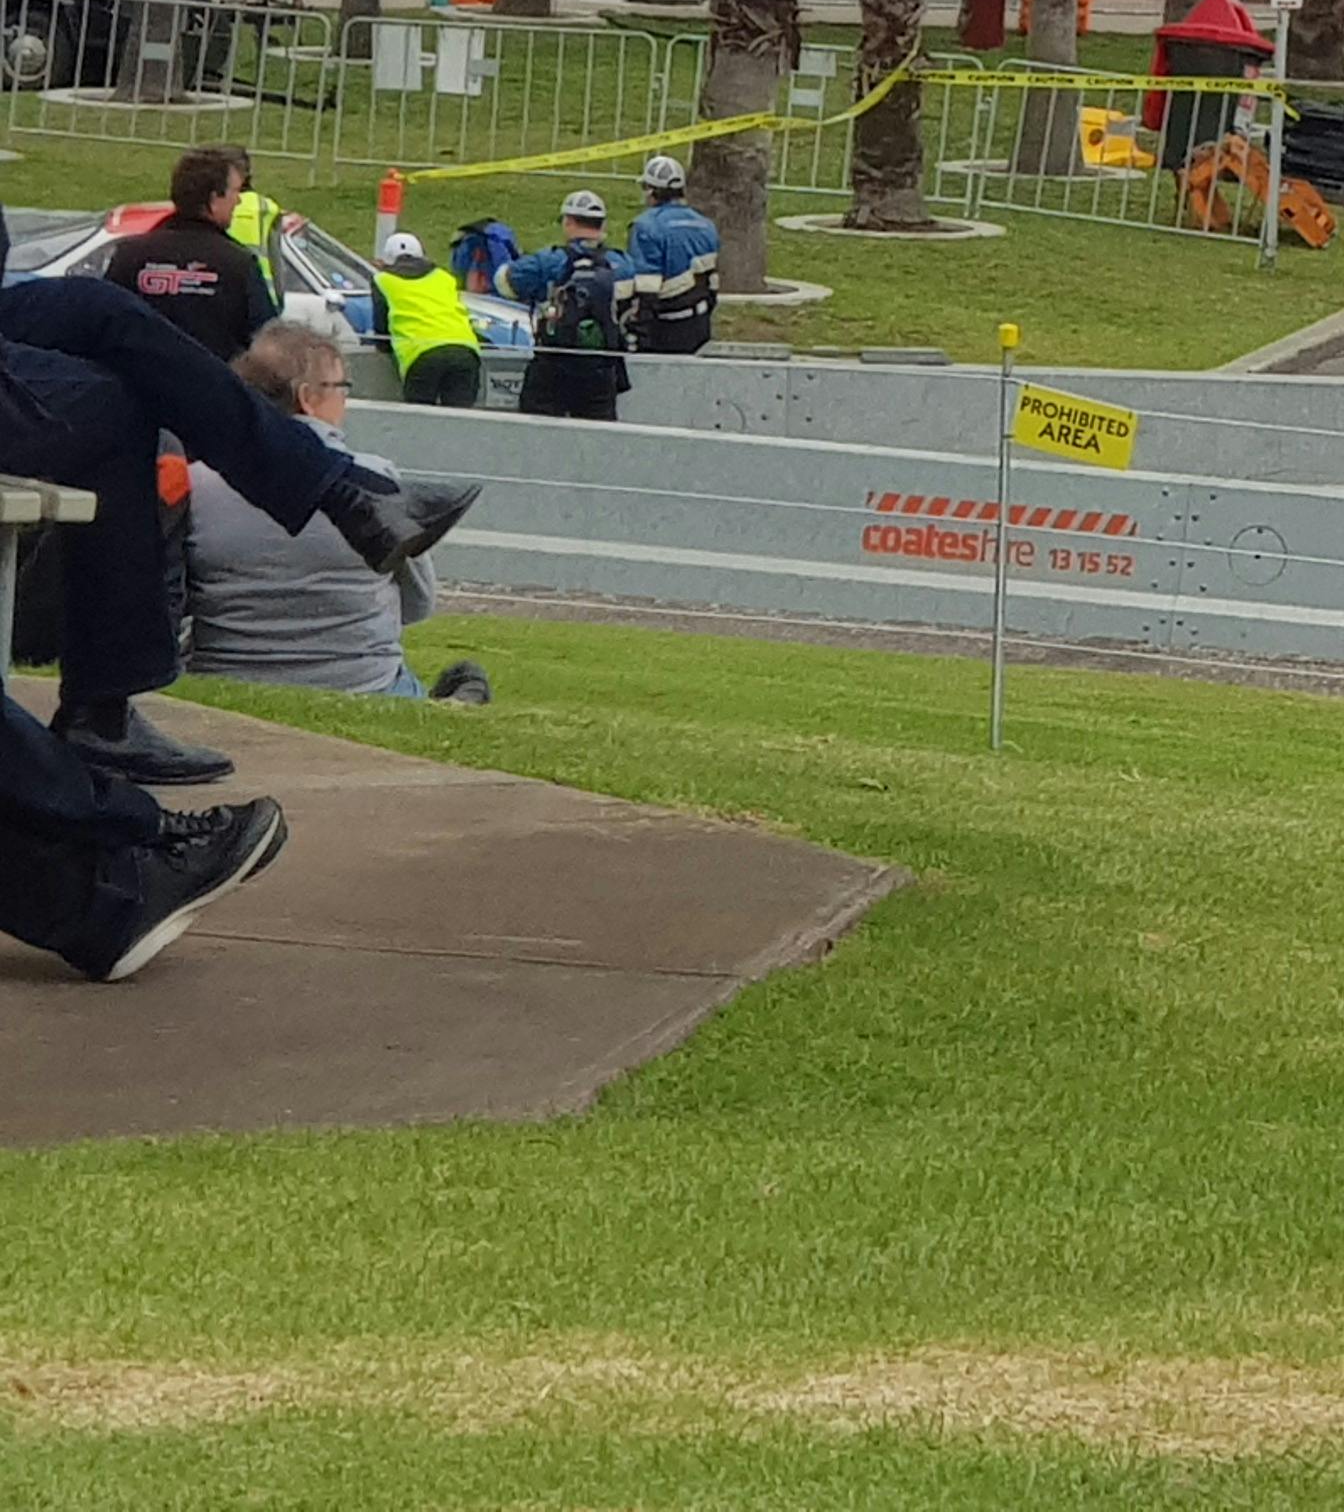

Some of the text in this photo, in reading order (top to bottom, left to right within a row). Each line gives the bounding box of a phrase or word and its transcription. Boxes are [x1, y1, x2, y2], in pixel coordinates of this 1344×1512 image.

[1019, 395, 1130, 439] PROHIBITED
[1038, 422, 1101, 454] AREA
[1049, 548, 1071, 570] 13
[1077, 550, 1100, 573] 15
[1106, 553, 1133, 576] 52
